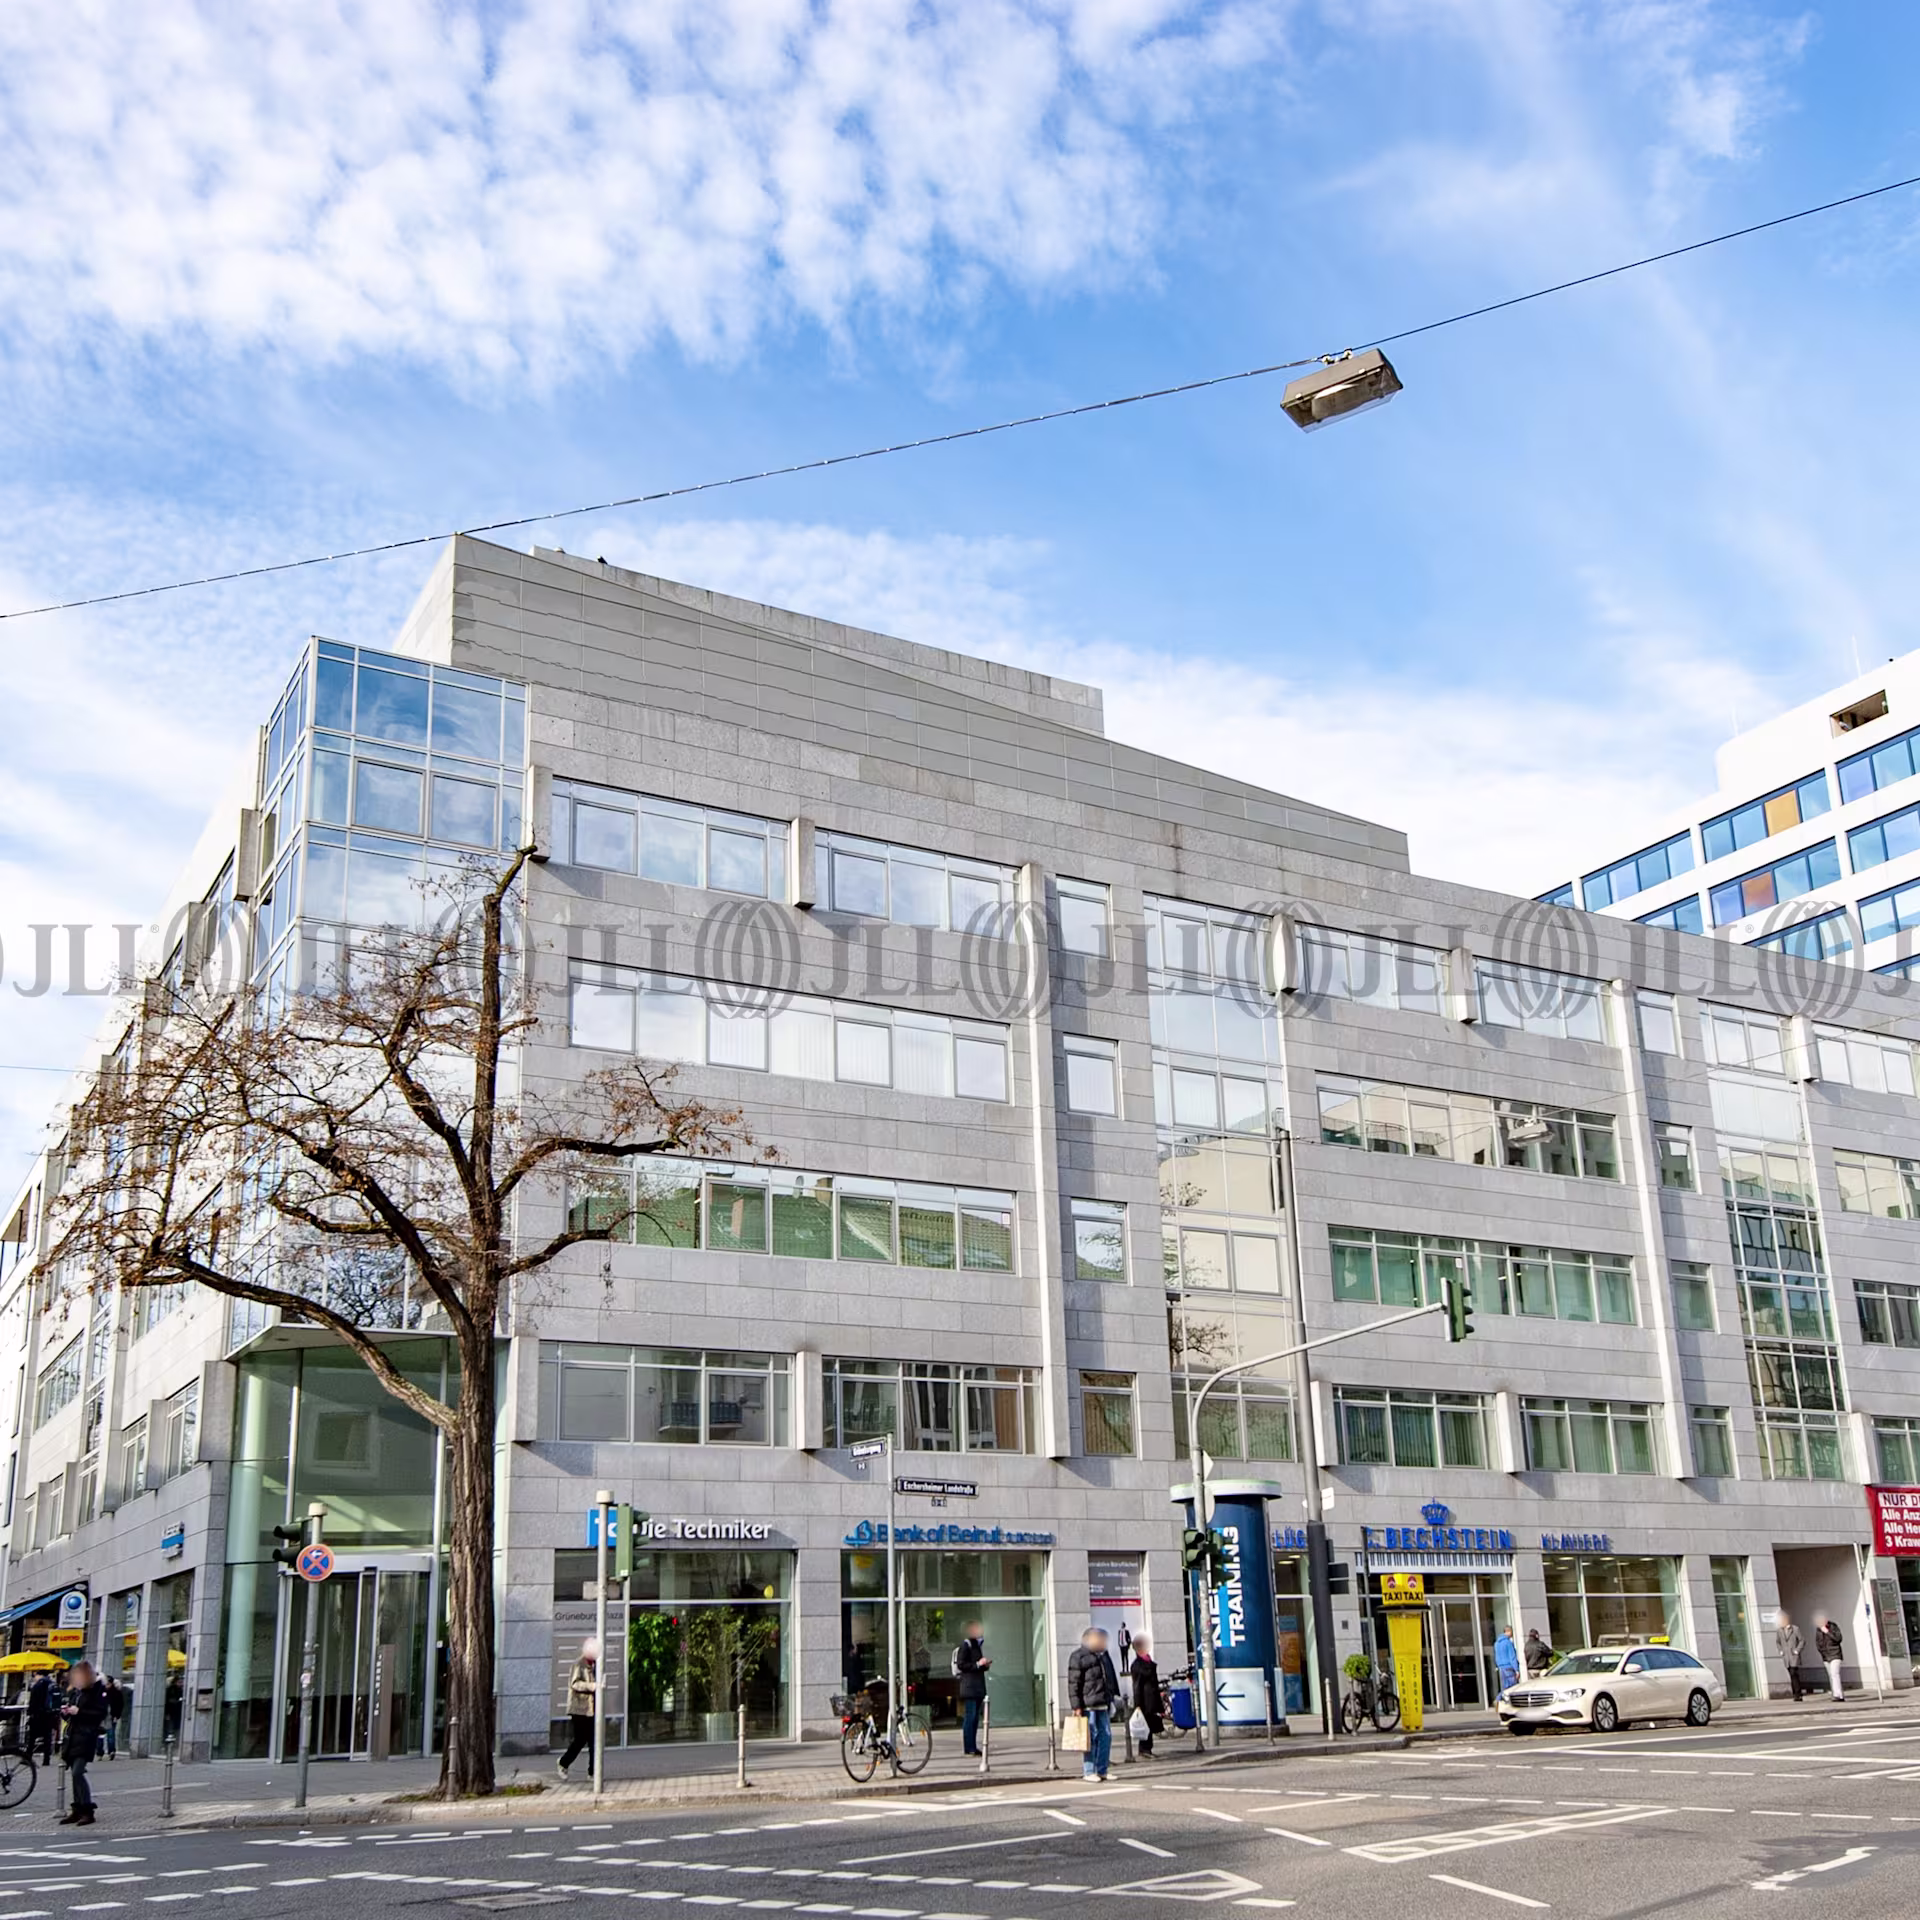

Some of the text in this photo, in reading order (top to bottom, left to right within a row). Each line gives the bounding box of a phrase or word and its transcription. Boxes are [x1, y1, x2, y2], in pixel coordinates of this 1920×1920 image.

[1883, 1494, 1908, 1506] NUR
[1882, 1508, 1900, 1520] Alle
[672, 1518, 772, 1539] Techniker
[876, 1523, 924, 1543] Bank
[926, 1524, 946, 1542] of
[1884, 1521, 1903, 1534] Alle
[1385, 1527, 1512, 1550] BECHSTEIN
[1541, 1533, 1613, 1551] KLAVIERE
[1885, 1535, 1893, 1548] 3
[1383, 1591, 1424, 1601] TAXI TAXI
